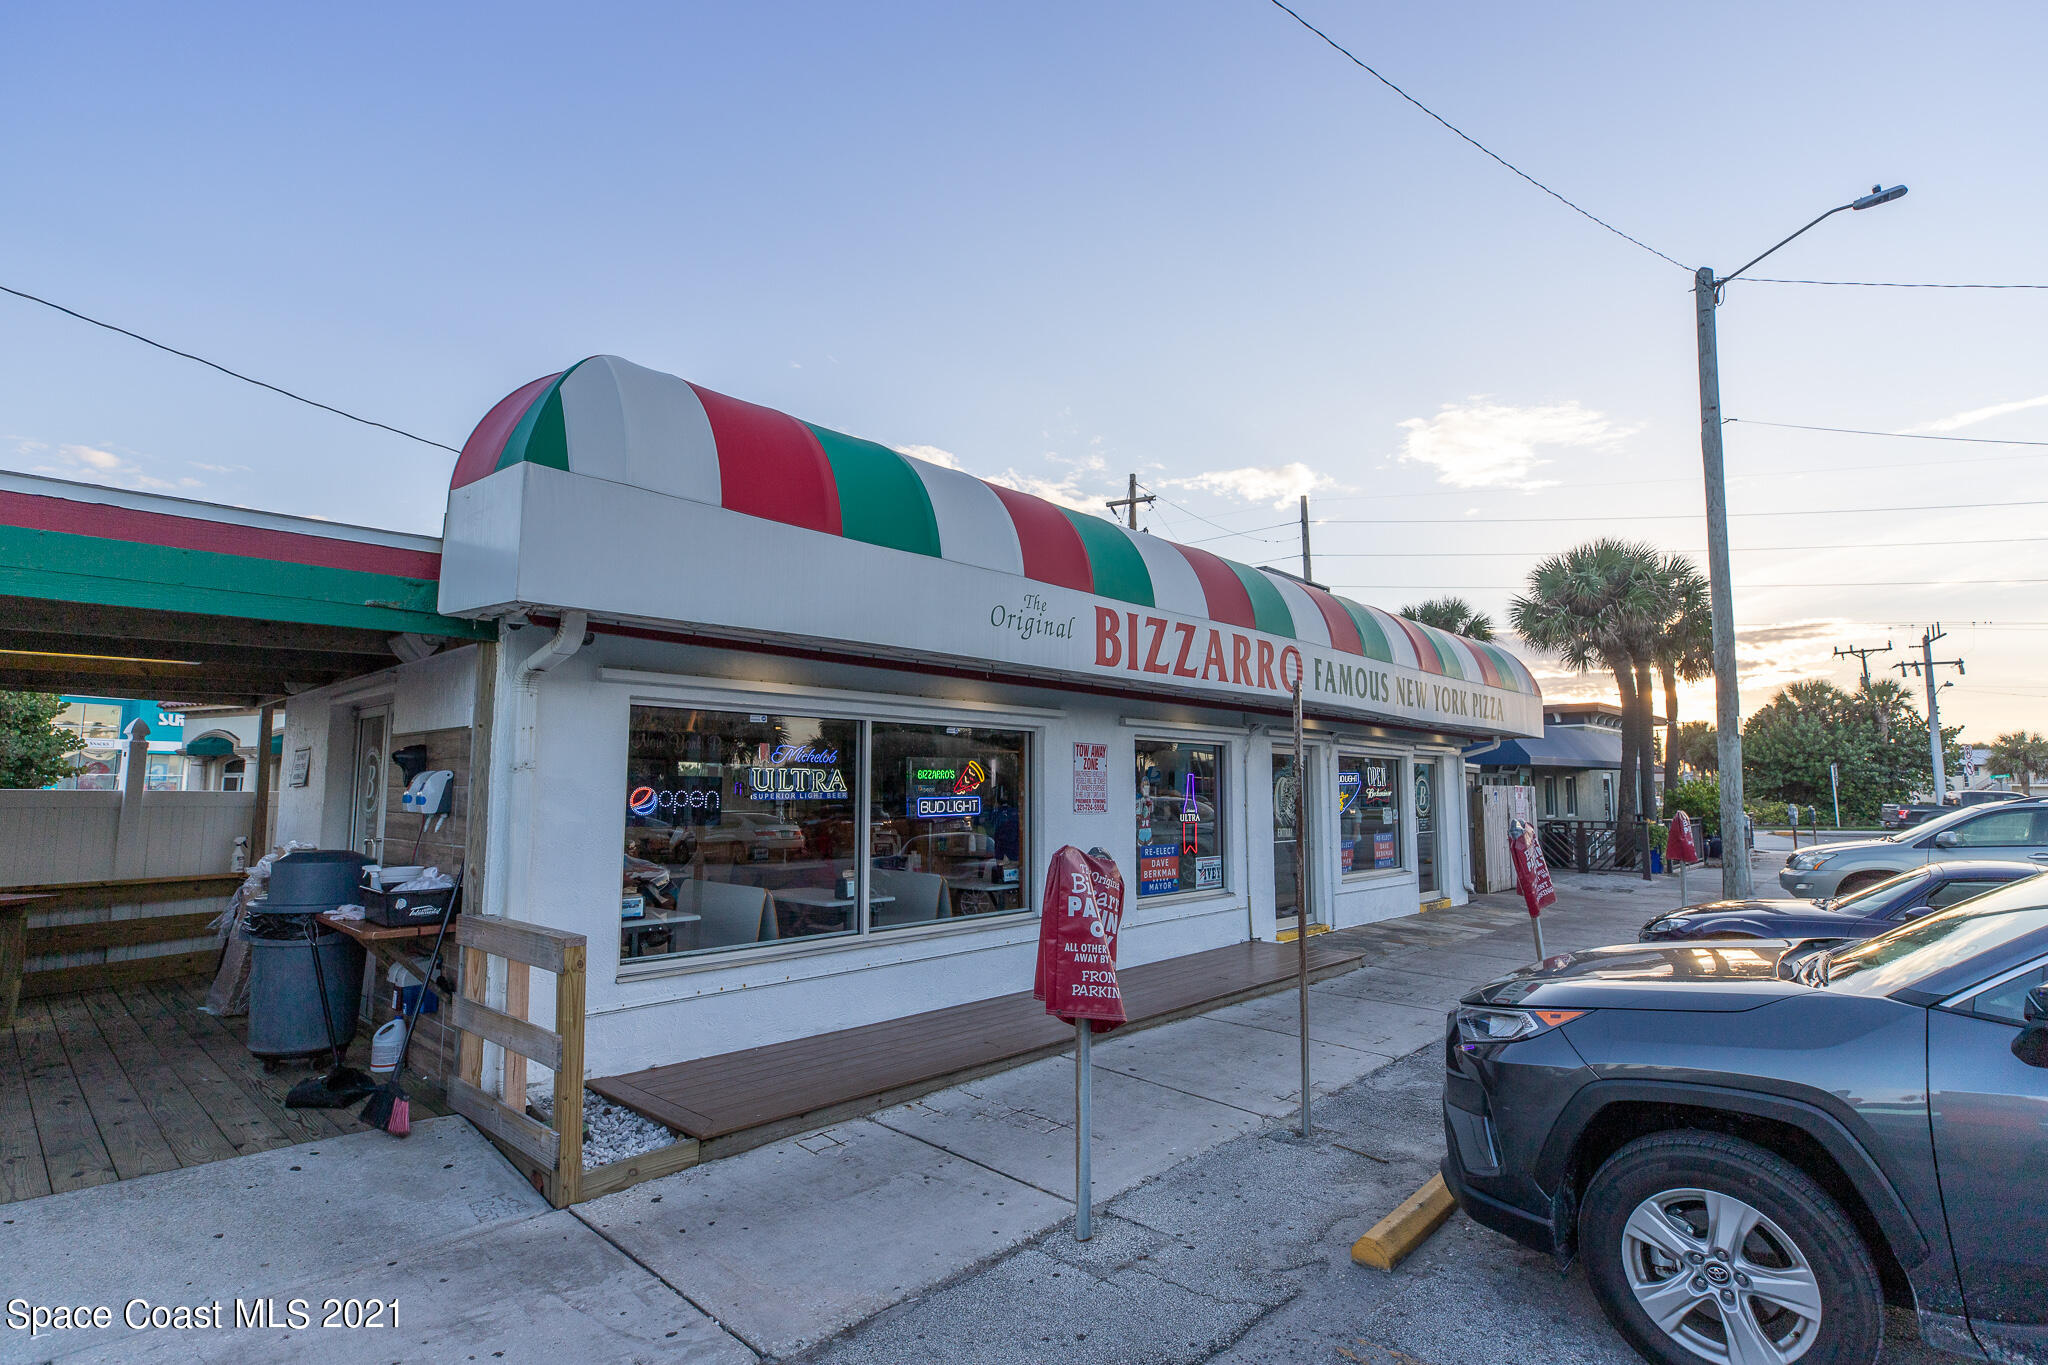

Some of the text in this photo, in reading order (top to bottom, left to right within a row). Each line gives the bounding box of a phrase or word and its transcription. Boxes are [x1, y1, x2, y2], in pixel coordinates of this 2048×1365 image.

[1023, 594, 1048, 612] The
[990, 605, 1076, 641] Original
[1094, 605, 1505, 722] BIZZARRO FAMOUS NEW YORK PIZZA
[771, 744, 839, 765] Michelob
[1076, 744, 1106, 759] TOW AWAY
[1083, 757, 1099, 770] ZONE
[751, 767, 848, 793] ULTRA
[1367, 766, 1387, 787] OPEN
[658, 789, 720, 815] open
[752, 792, 849, 800] SUPERIOR LIGHT BEER
[920, 799, 978, 814] BUD LIGHT
[1180, 814, 1201, 822] ULTRA
[1144, 846, 1175, 856] RE-ELECT
[1151, 858, 1169, 868] DAVE
[1143, 868, 1177, 879] BERKMAN
[1149, 881, 1172, 890] MAYOR
[1064, 942, 1108, 954] ALL OTHER
[1074, 952, 1110, 964] AWAY BY
[1081, 970, 1116, 984] FRON
[1071, 984, 1120, 999] PARKIN
